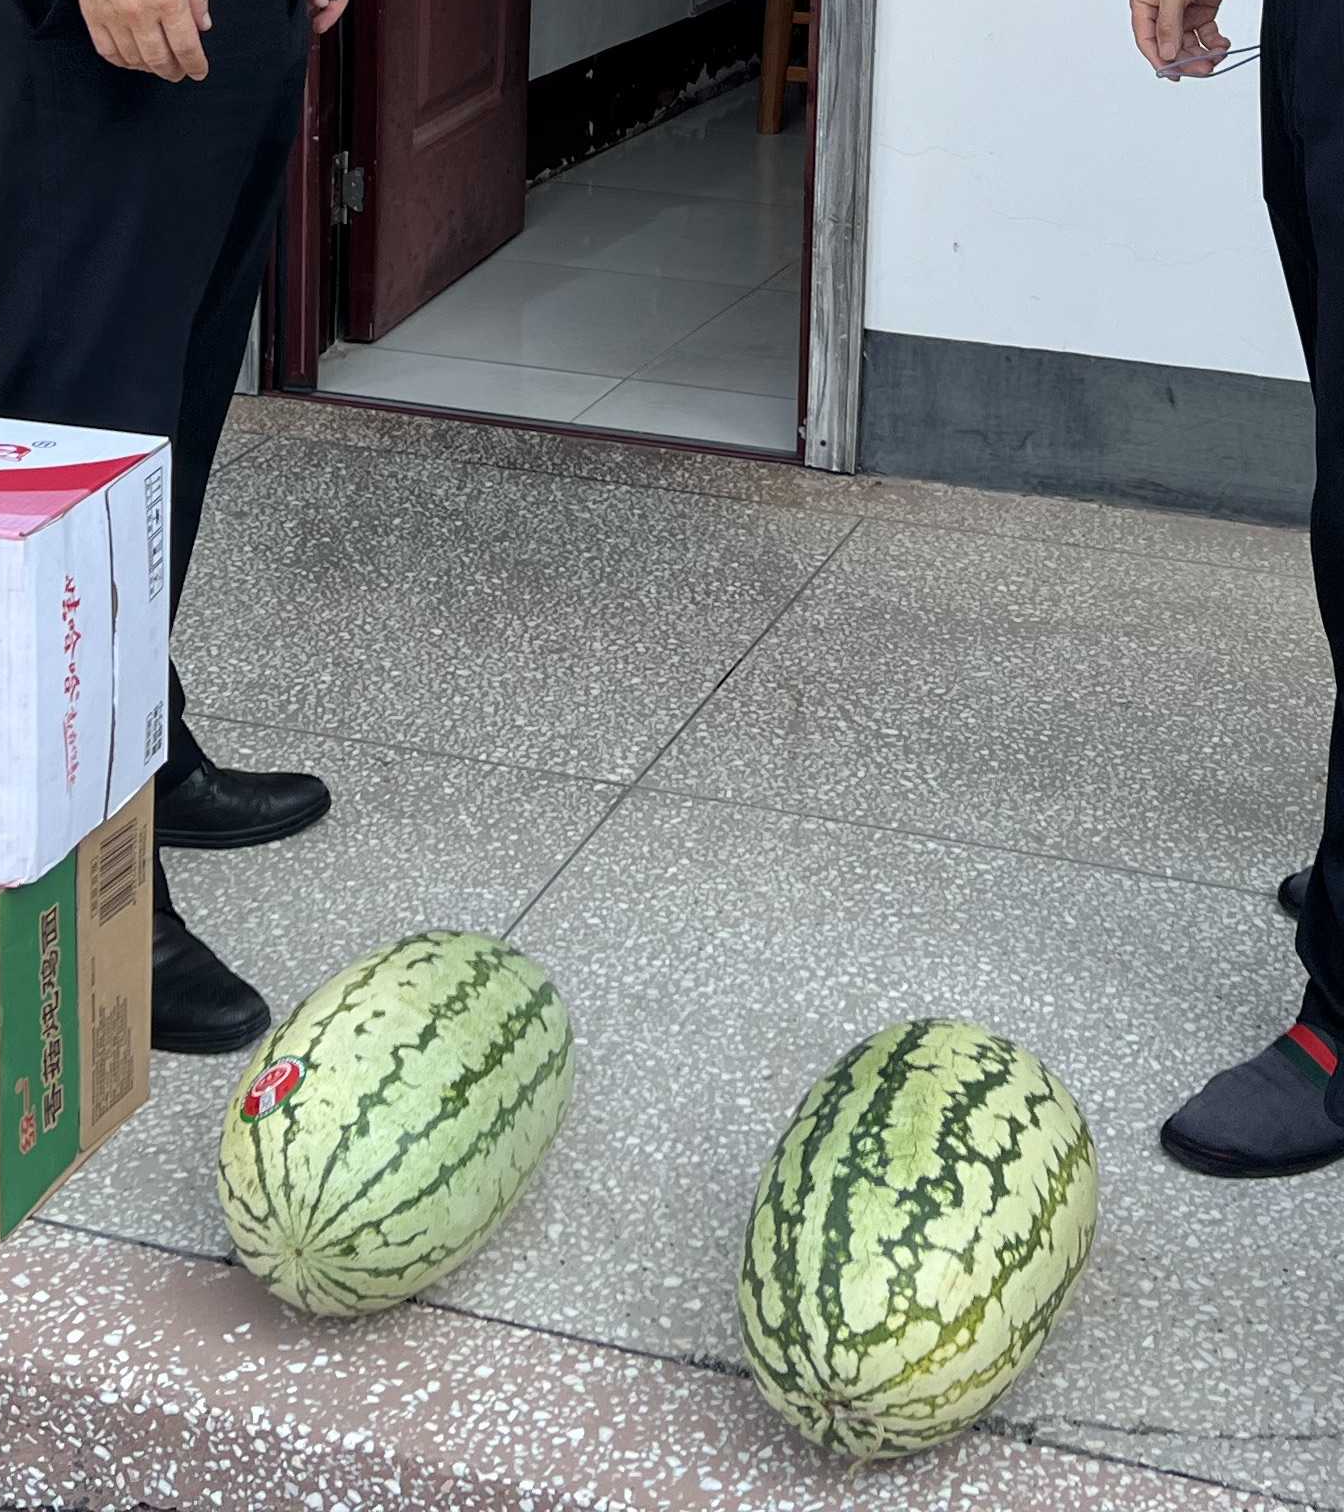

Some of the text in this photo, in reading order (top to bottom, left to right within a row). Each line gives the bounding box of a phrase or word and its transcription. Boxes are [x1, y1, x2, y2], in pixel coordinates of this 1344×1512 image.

[40, 903, 63, 1133] 香菇炖鸡面
